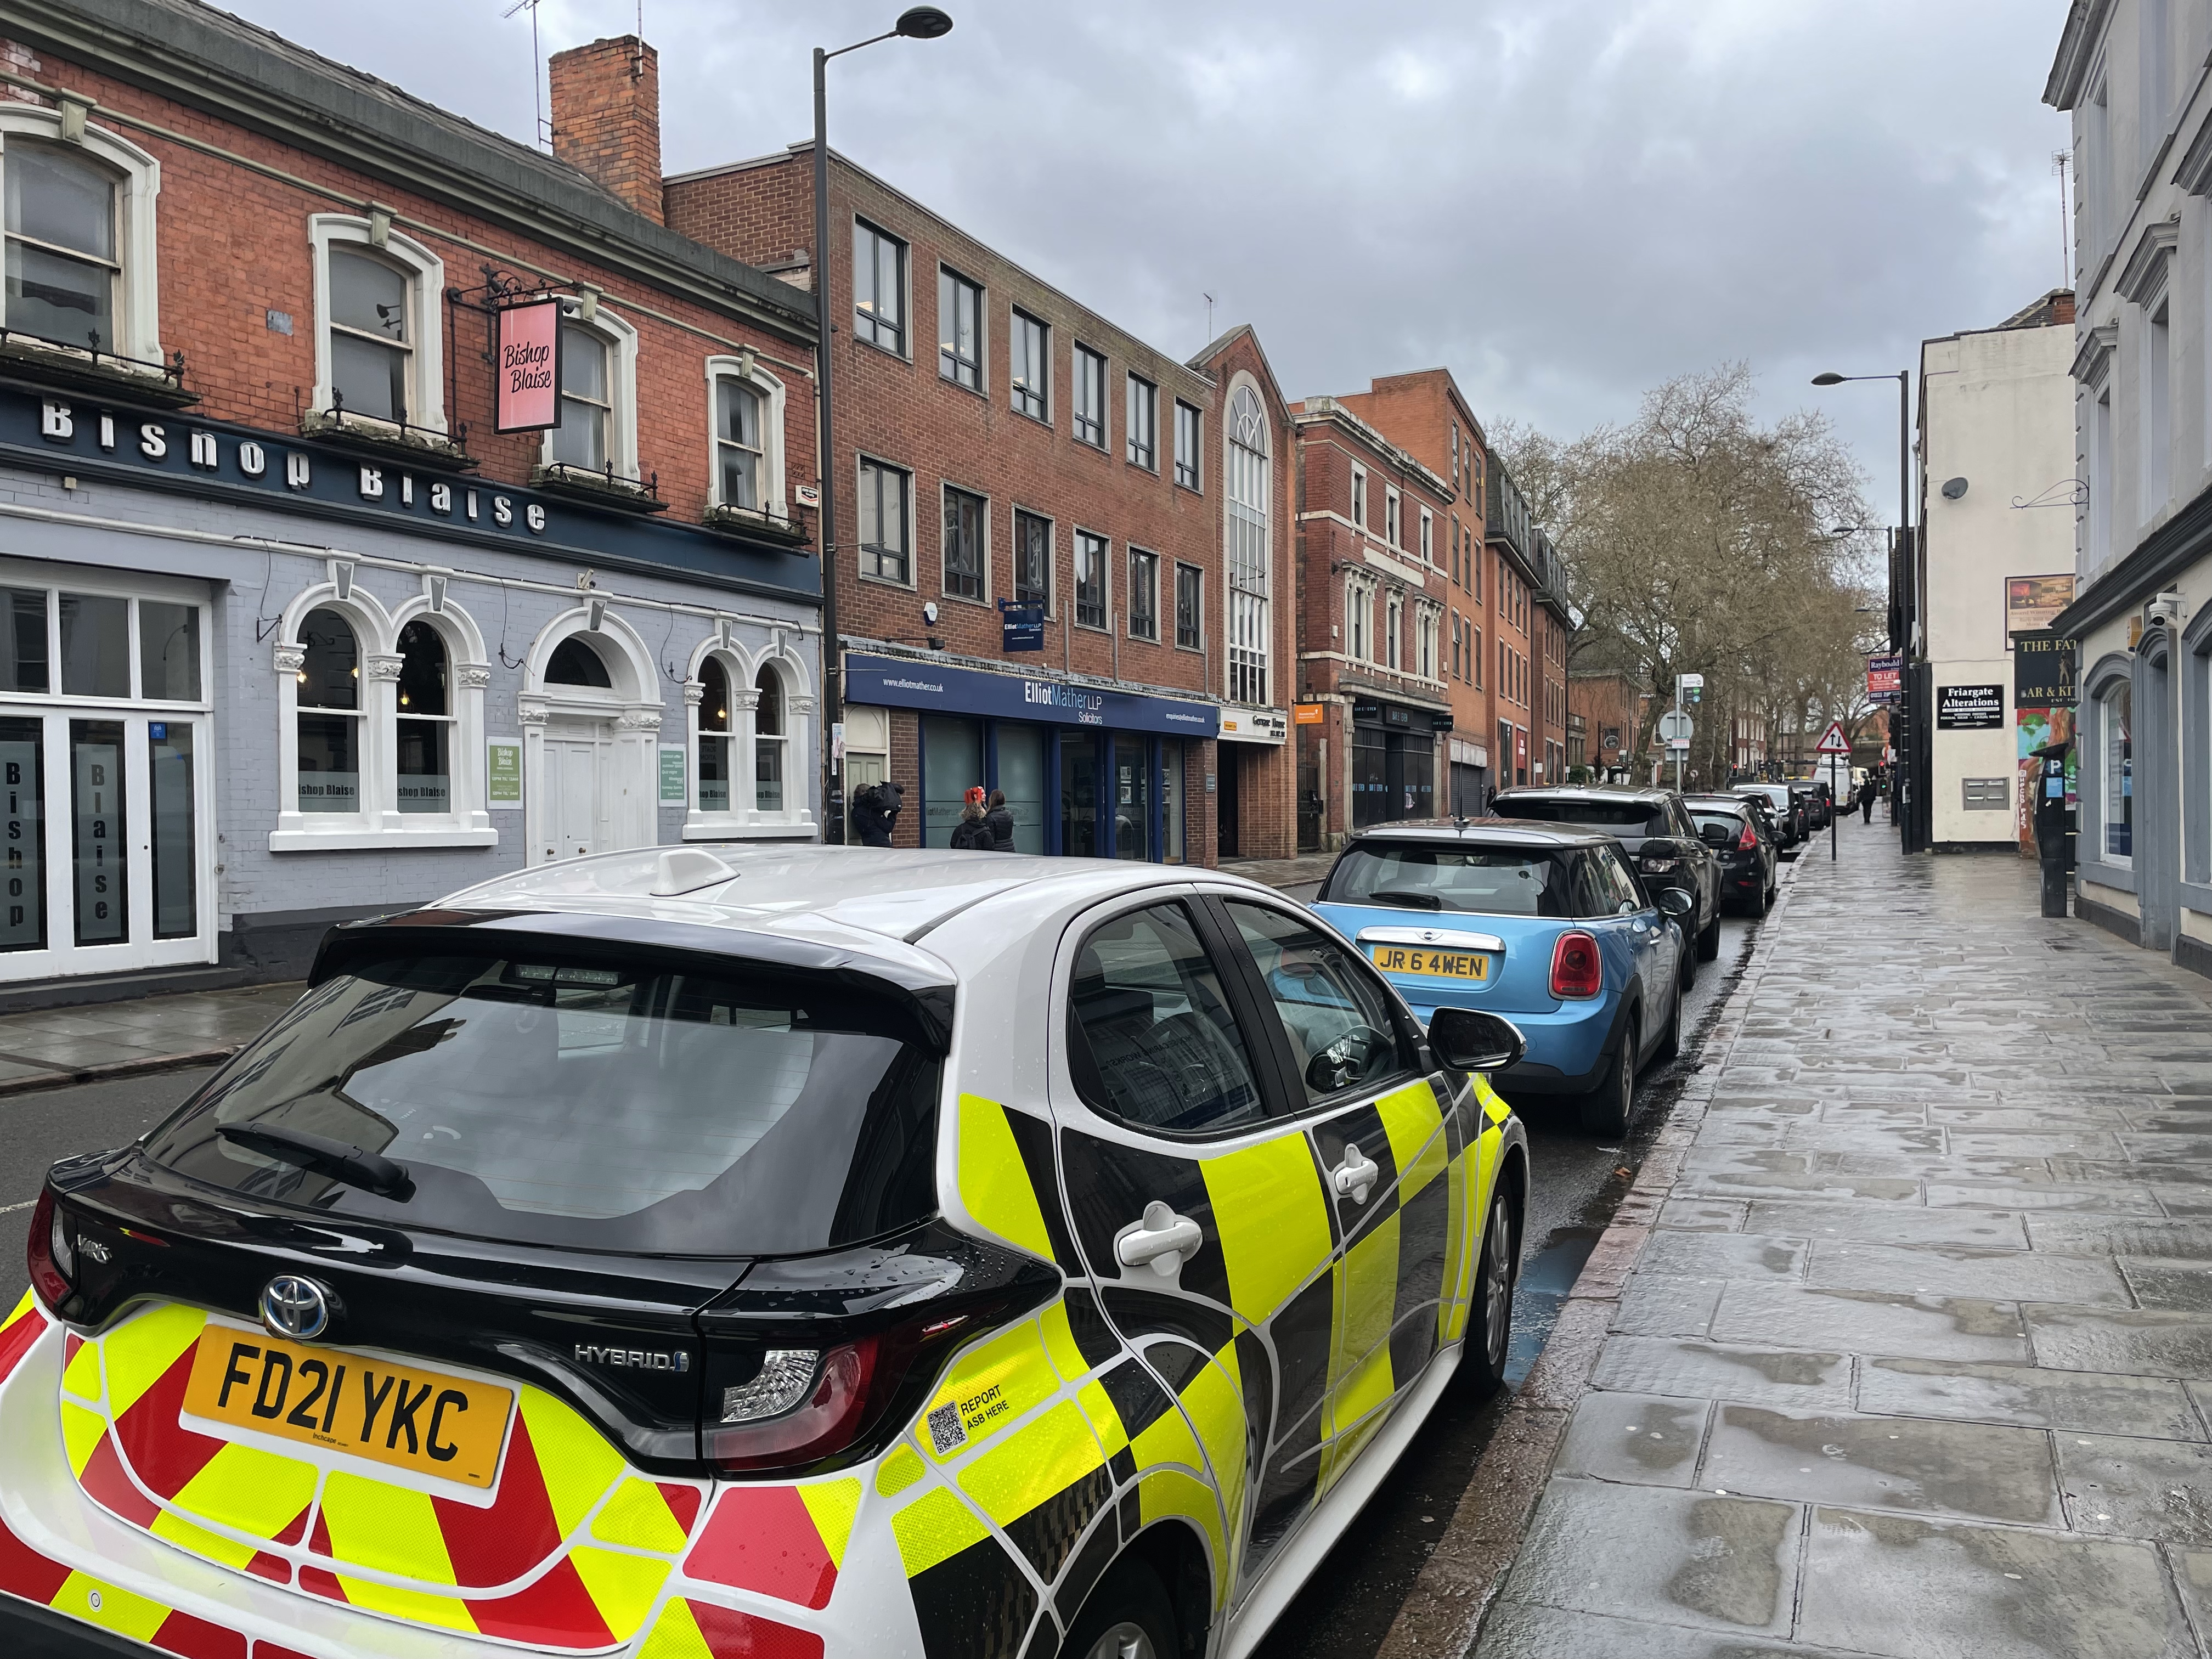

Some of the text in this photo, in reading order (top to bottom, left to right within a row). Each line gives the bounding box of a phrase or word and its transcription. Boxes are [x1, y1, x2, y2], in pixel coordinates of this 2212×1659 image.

[505, 342, 549, 370] Bishop
[511, 368, 551, 393] Blaise
[41, 396, 546, 532] Bishop Blaise
[2021, 640, 2051, 652] THE
[1871, 659, 1900, 670] Raybould
[883, 678, 944, 692] www.elliotmather.co.uk
[1948, 687, 1994, 698] Friargate
[2021, 686, 2043, 698] BAR
[2047, 686, 2055, 697] &
[1943, 698, 1999, 707] Alterations
[1078, 711, 1103, 725] Solicitors
[2051, 760, 2061, 775] P
[298, 784, 355, 796] ishop Blaise
[398, 786, 445, 797] shop Blaise
[6, 762, 24, 927] Bishop
[91, 764, 108, 920] Blaise
[1380, 951, 1405, 969] JR
[77, 1233, 112, 1265] YARIS
[575, 1345, 670, 1370] HYBRID
[217, 1342, 469, 1462] FD21 YKC
[961, 1384, 1001, 1416] REPORT
[967, 1400, 1009, 1431] ASB HERE
[313, 1432, 337, 1444] Inchcape
